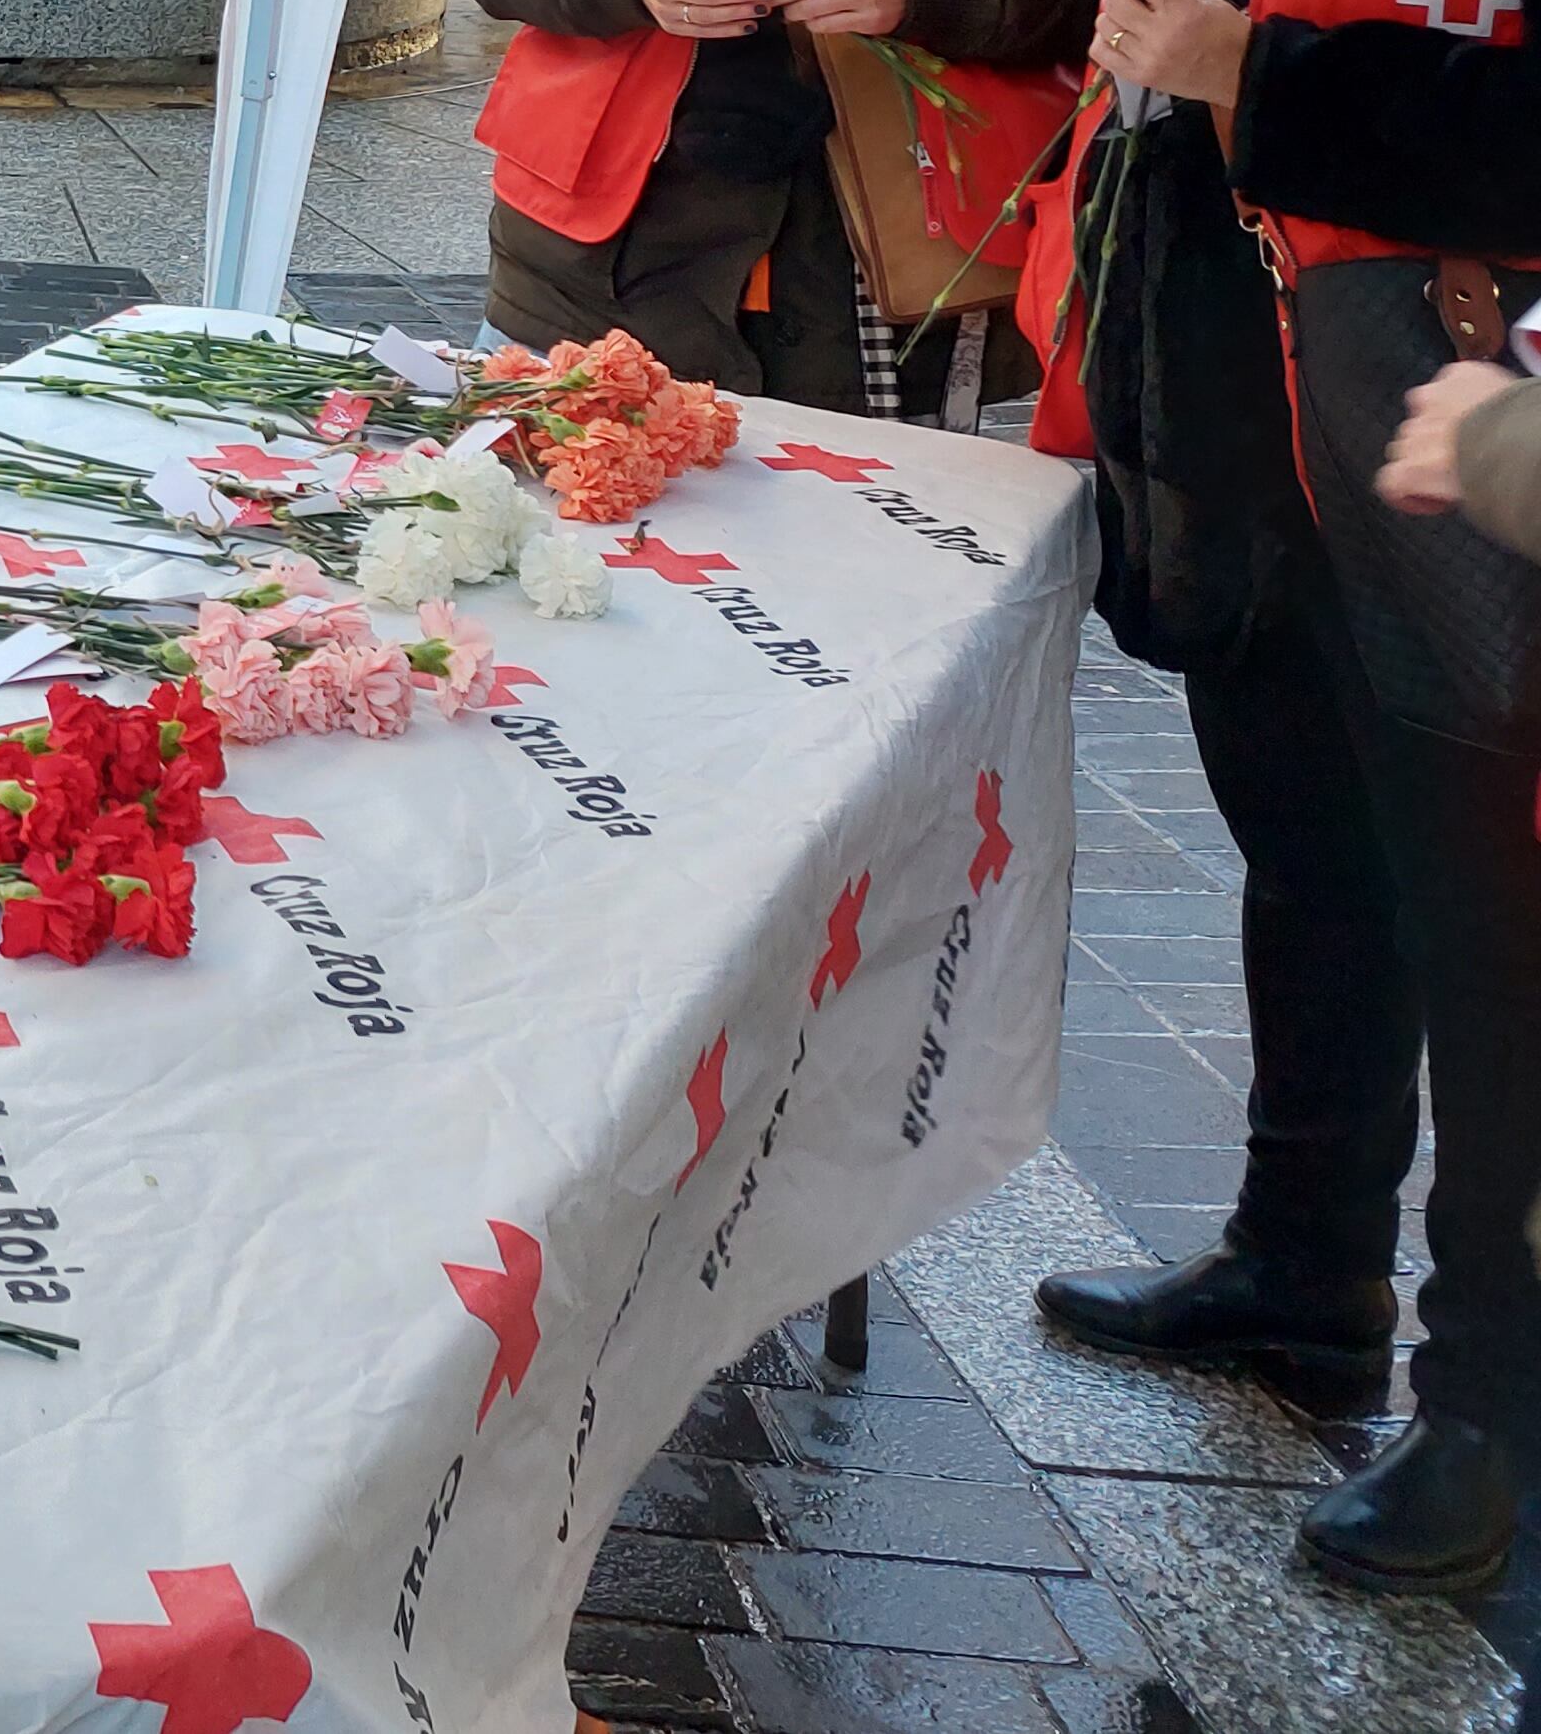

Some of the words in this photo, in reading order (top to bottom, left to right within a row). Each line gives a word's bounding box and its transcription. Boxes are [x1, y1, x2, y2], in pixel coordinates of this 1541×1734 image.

[854, 488, 942, 526] Cruz
[913, 524, 1007, 567] Roja
[691, 586, 782, 635] Cruz
[752, 638, 852, 688] Roja
[490, 713, 587, 770] Cruz
[553, 774, 659, 839] Roja
[248, 871, 345, 937] Cruz
[307, 944, 406, 1039] Roja
[394, 1454, 464, 1654] Cruz
